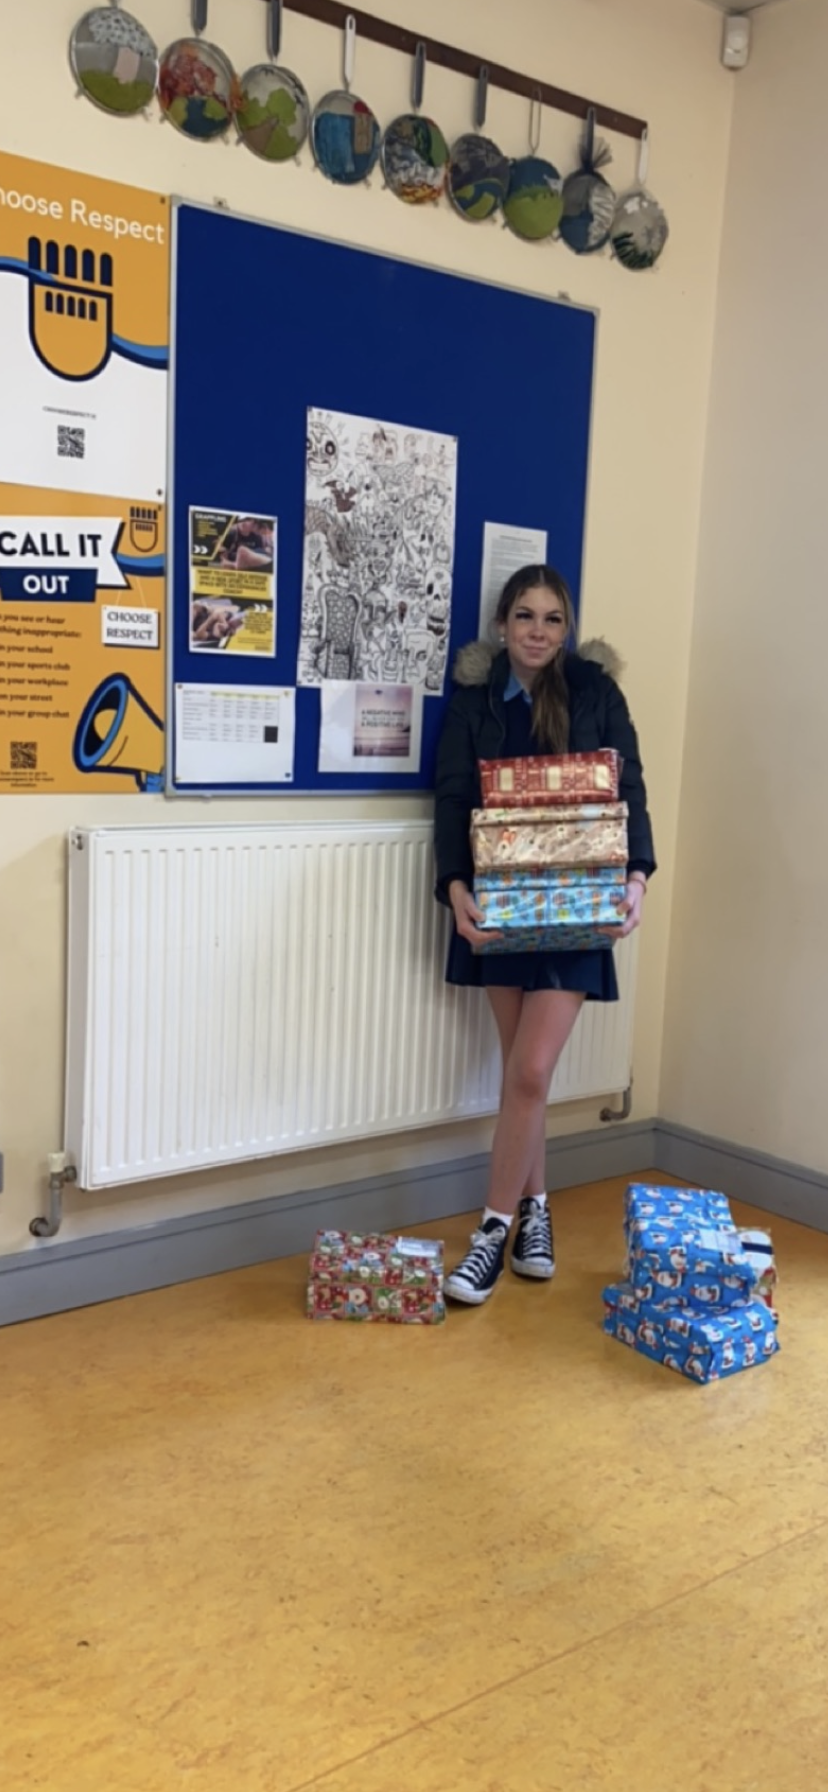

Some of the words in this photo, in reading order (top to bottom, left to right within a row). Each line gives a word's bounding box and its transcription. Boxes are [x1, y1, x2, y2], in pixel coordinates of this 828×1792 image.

[71, 198, 165, 244] Respect
[0, 531, 70, 557] CALL
[79, 534, 102, 557] IT
[23, 575, 70, 594] OUT
[46, 614, 66, 624] hear
[107, 611, 152, 624] CHOOSE
[107, 627, 153, 640] RESPECT
[7, 645, 25, 653] your
[27, 645, 53, 654] school
[7, 661, 25, 669] your
[27, 662, 52, 671] sports
[53, 662, 71, 671] club
[7, 678, 25, 686] your
[27, 678, 69, 688] workplace
[10, 694, 28, 702] your
[29, 693, 53, 702] street
[7, 710, 26, 718] your
